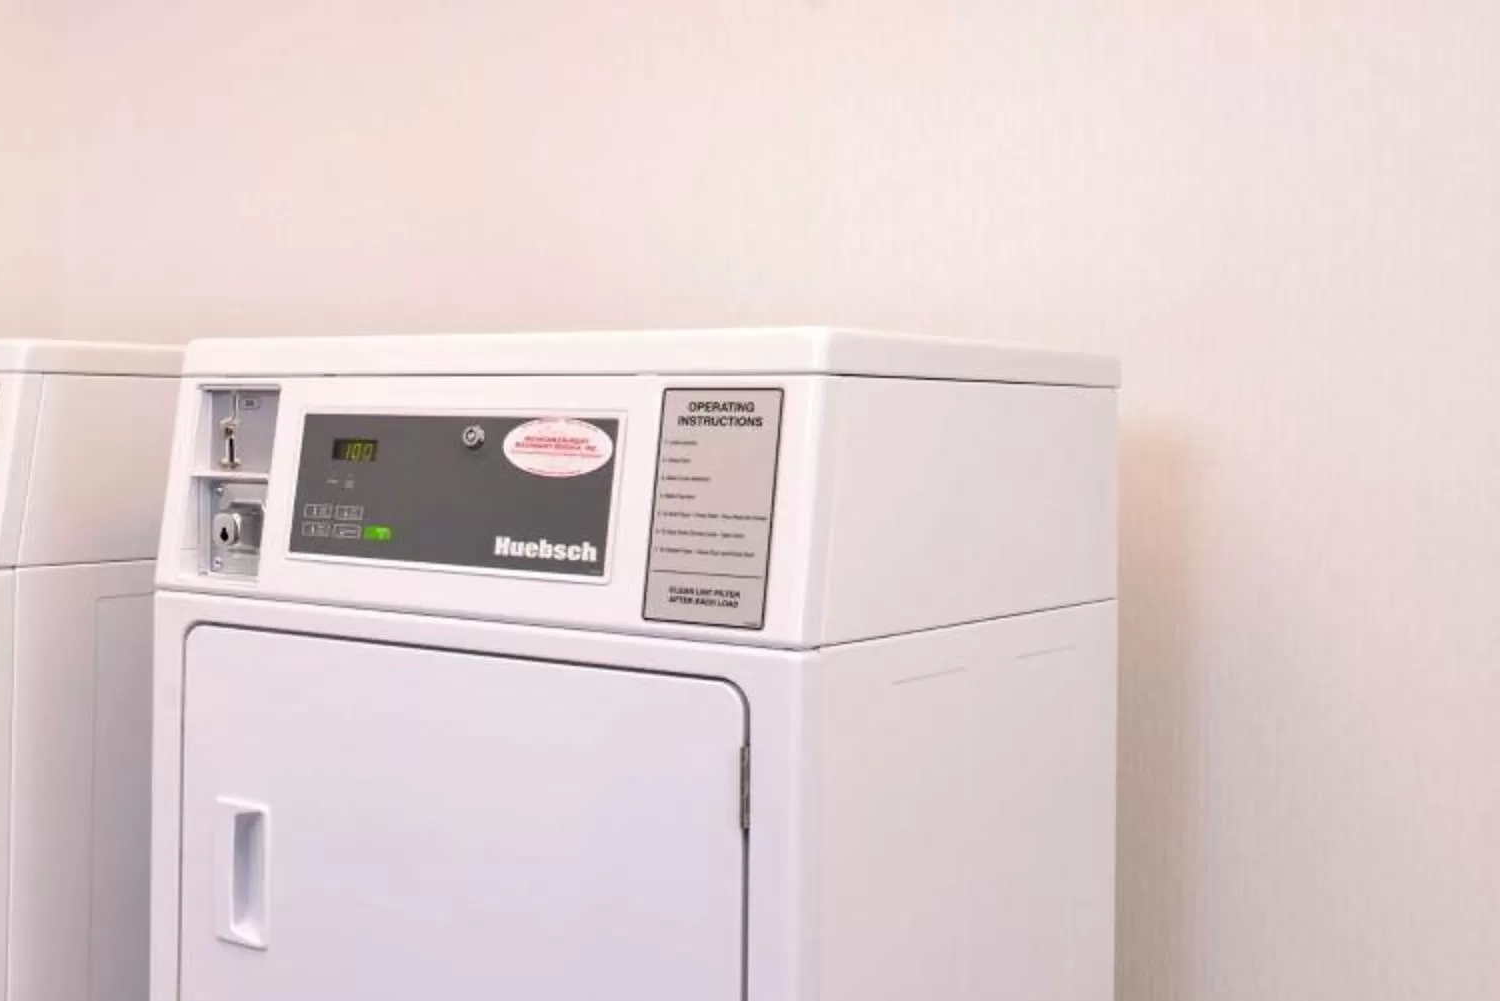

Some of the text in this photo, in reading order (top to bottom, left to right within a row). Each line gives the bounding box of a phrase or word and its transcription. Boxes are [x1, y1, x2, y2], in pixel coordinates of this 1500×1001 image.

[688, 401, 755, 413] OPERATING
[677, 415, 764, 427] INSTRUCTIONS
[345, 443, 374, 461] 100
[494, 535, 598, 562] Huebsch
